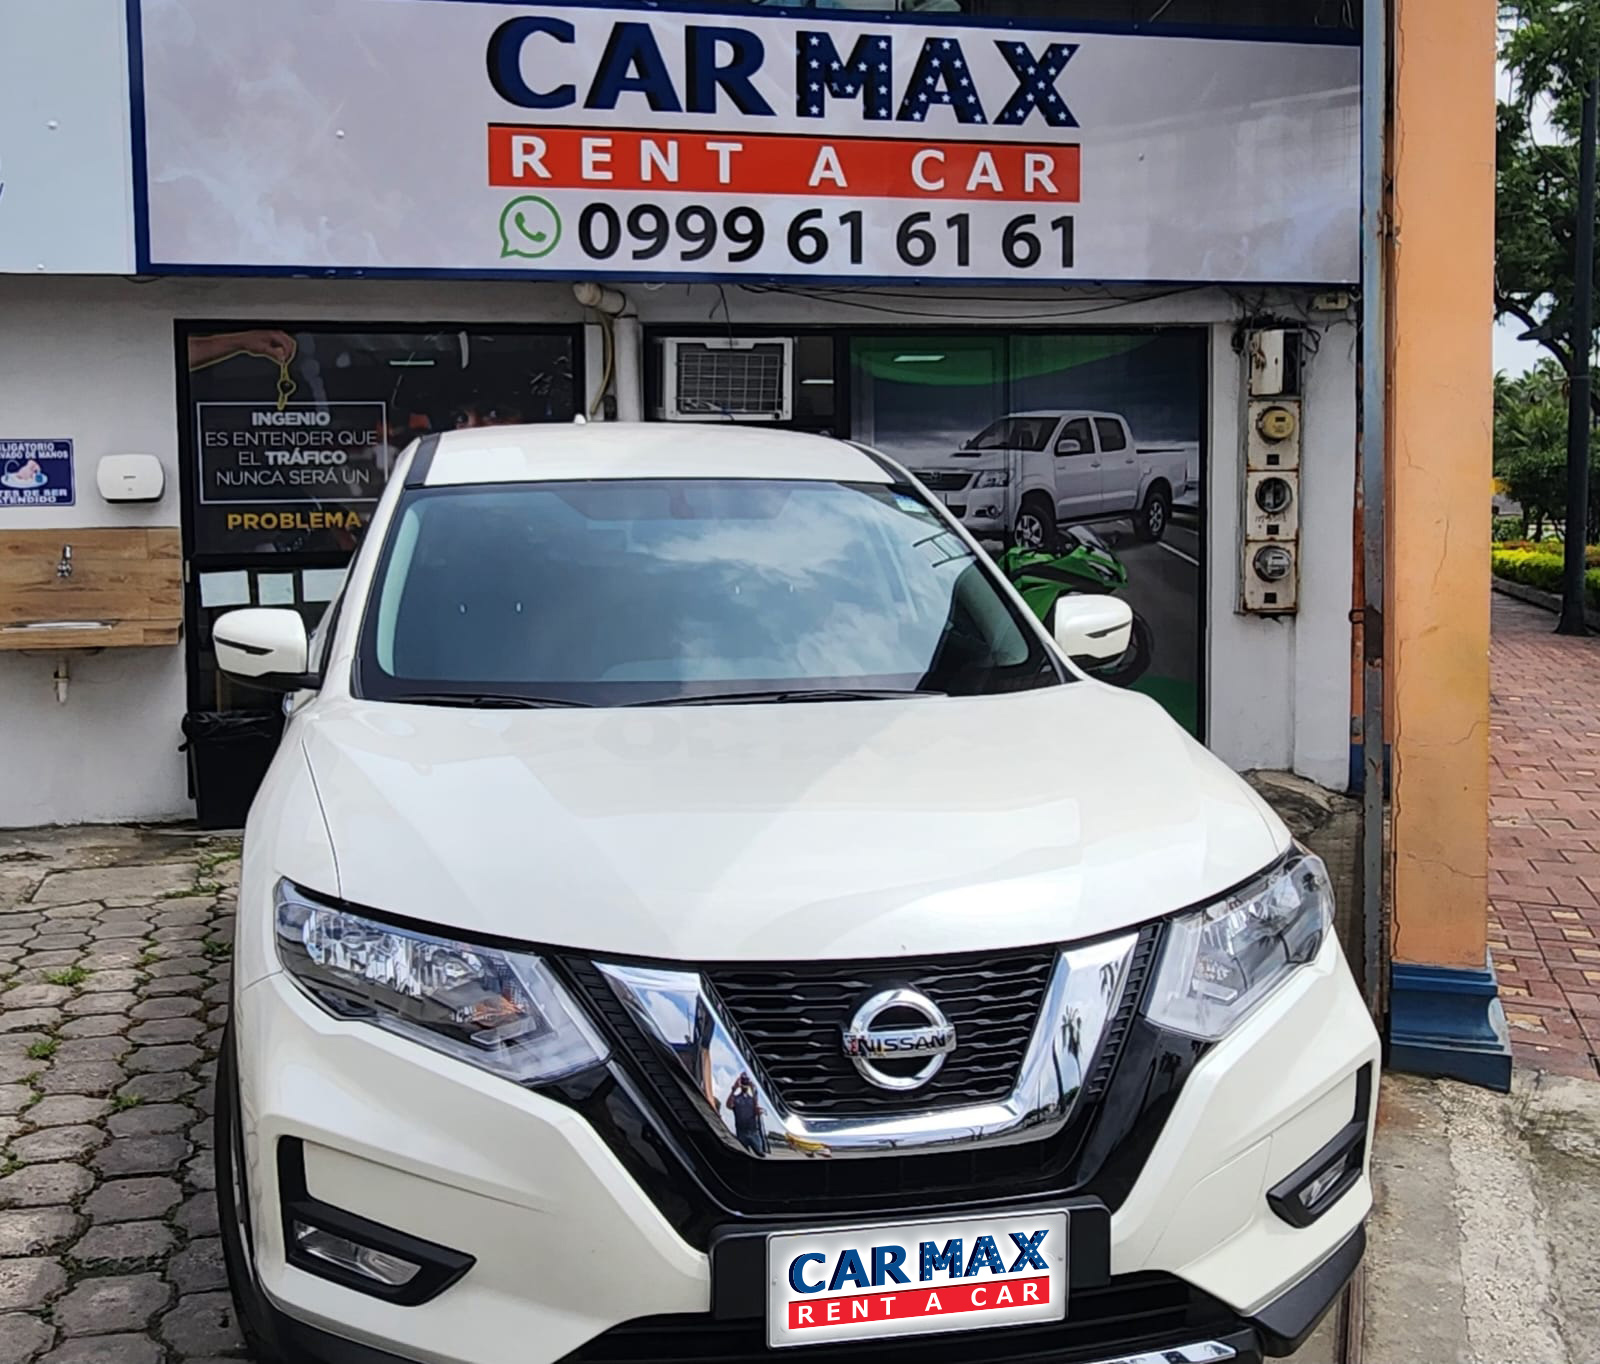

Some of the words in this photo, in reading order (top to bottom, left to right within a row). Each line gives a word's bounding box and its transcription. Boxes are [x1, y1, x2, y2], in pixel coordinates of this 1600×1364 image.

[510, 134, 743, 184] RENT
[808, 146, 848, 188] A
[910, 149, 1059, 195] CAR
[577, 201, 765, 263] 0999
[787, 207, 863, 266] 61
[896, 211, 971, 267] 61
[1001, 213, 1075, 269] 61
[252, 412, 331, 426] INGENIO
[0, 443, 55, 451] LIGATORIO
[205, 432, 229, 446] ES
[233, 431, 334, 446] ENTENDER
[338, 430, 377, 446] QUE
[0, 451, 23, 459] VADO
[25, 451, 37, 459] DE
[239, 451, 262, 466] EL
[265, 448, 347, 466] TRÁFICO
[217, 471, 285, 486] NUNCA
[289, 466, 339, 485] SERÁ
[342, 469, 370, 484] UN
[227, 512, 362, 530] PROBLEMA
[857, 1035, 946, 1054] NISSAN
[798, 1296, 897, 1325] RENT
[925, 1293, 943, 1312] A
[971, 1283, 1040, 1308] CAR
